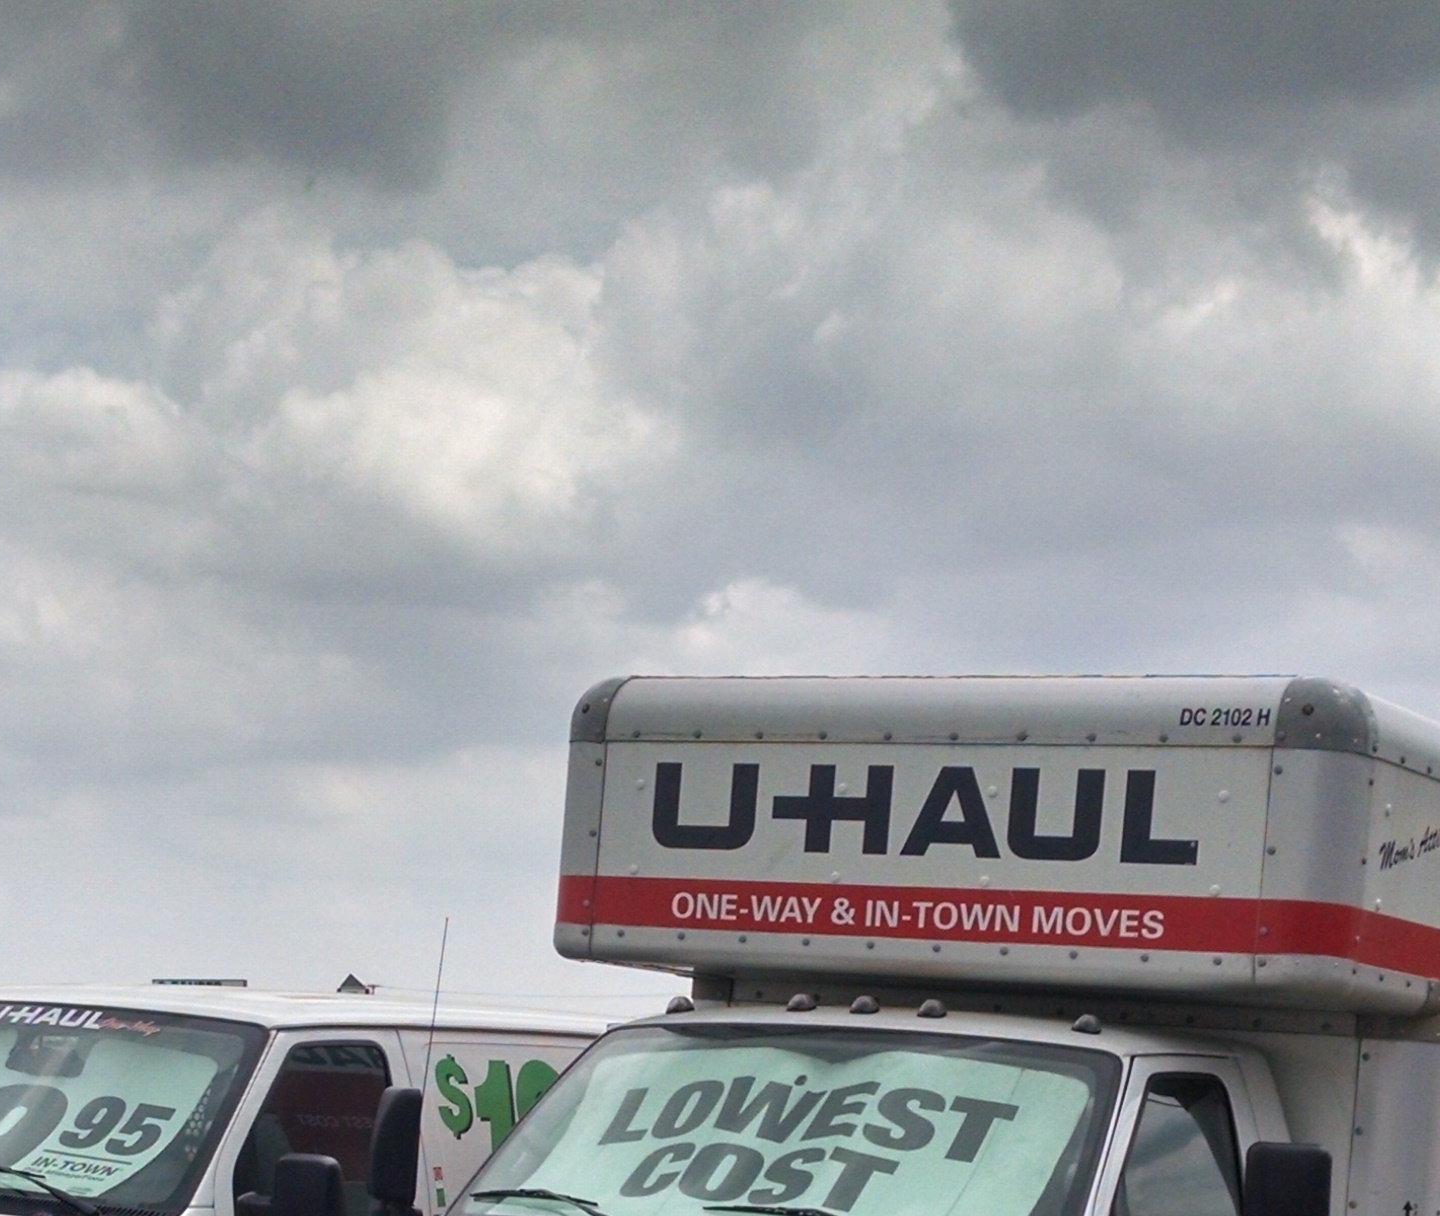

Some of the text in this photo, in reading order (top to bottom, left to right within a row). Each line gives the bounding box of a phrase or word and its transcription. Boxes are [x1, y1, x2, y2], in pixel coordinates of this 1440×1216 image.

[1179, 707, 1271, 726] DC 2102 H
[671, 890, 1166, 940] ONE-WAY & IN-TOWN MOVES
[59, 1095, 177, 1156] 95
[597, 1075, 1020, 1163] LOWEST
[31, 1156, 120, 1177] IN-TOWN
[619, 1142, 900, 1213] COST
